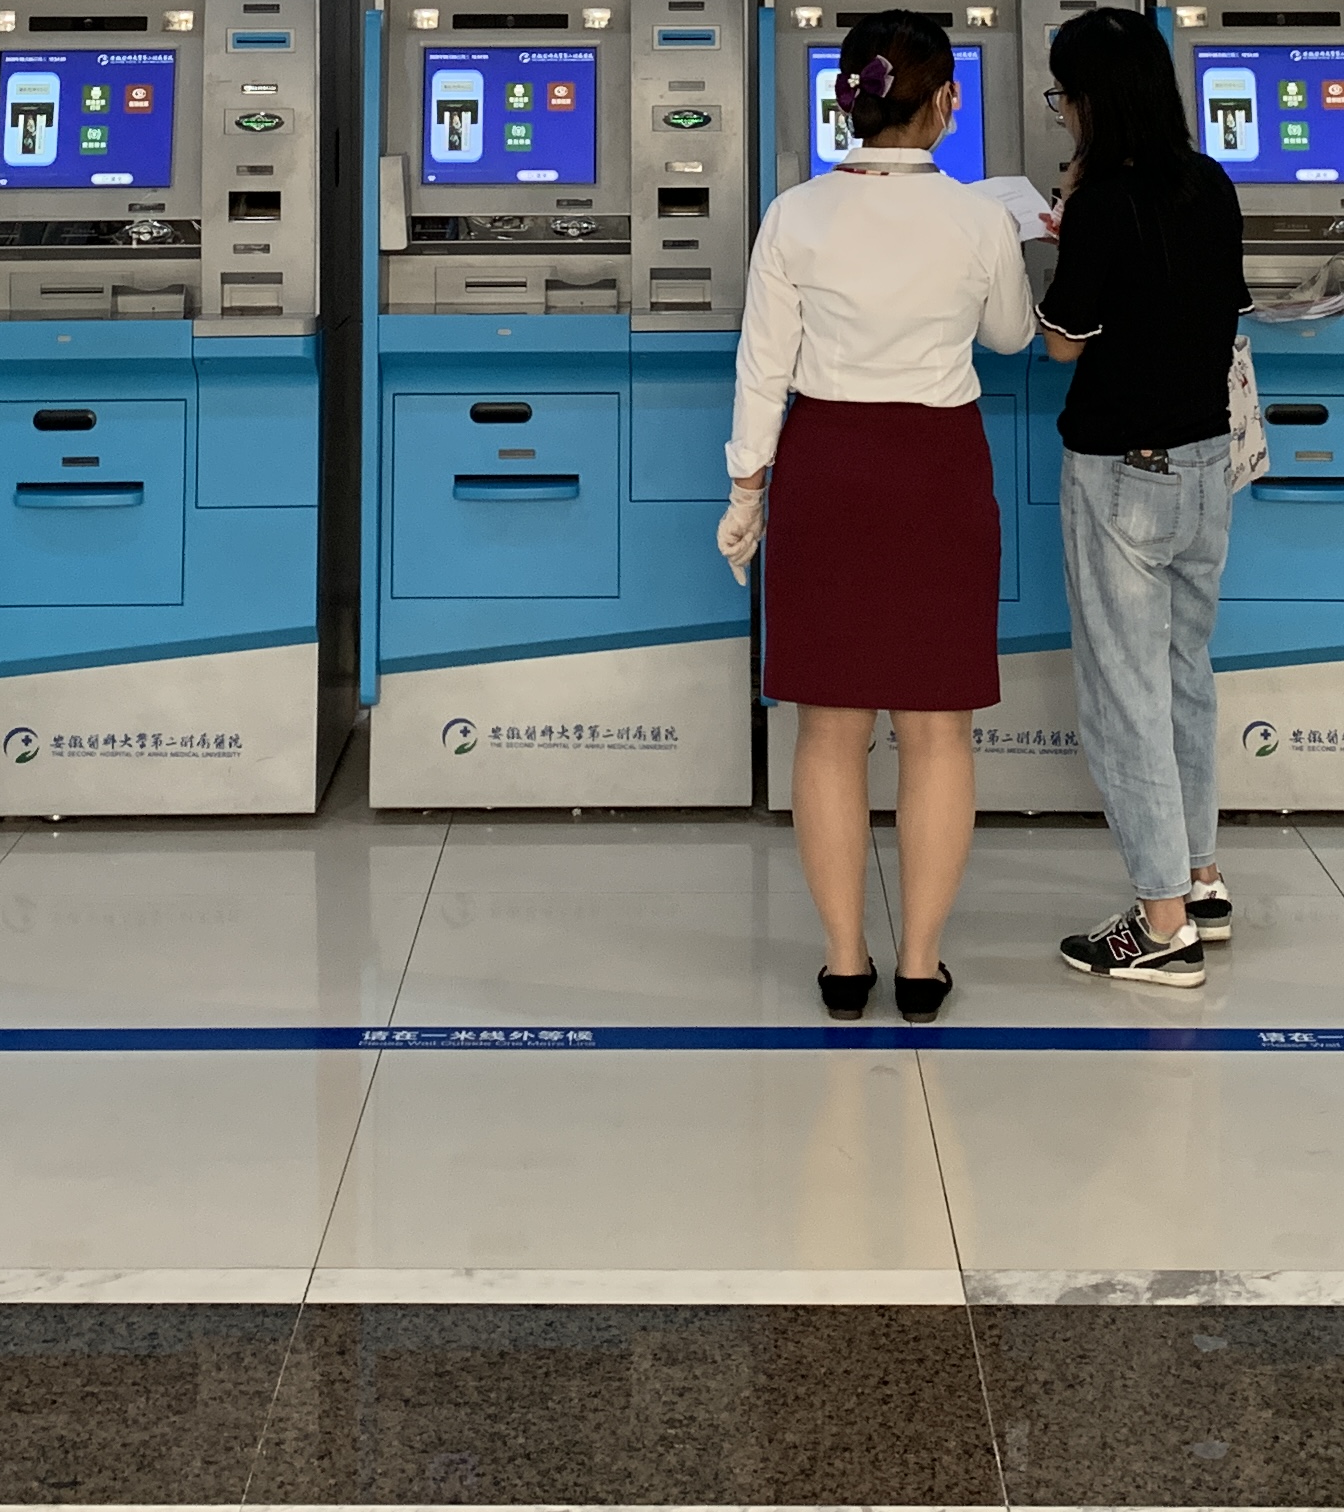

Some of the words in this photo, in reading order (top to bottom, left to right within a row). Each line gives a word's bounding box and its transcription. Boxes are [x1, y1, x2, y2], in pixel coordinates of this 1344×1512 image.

[1106, 930, 1142, 960] N
[362, 1031, 594, 1041] 请在一米线外等候
